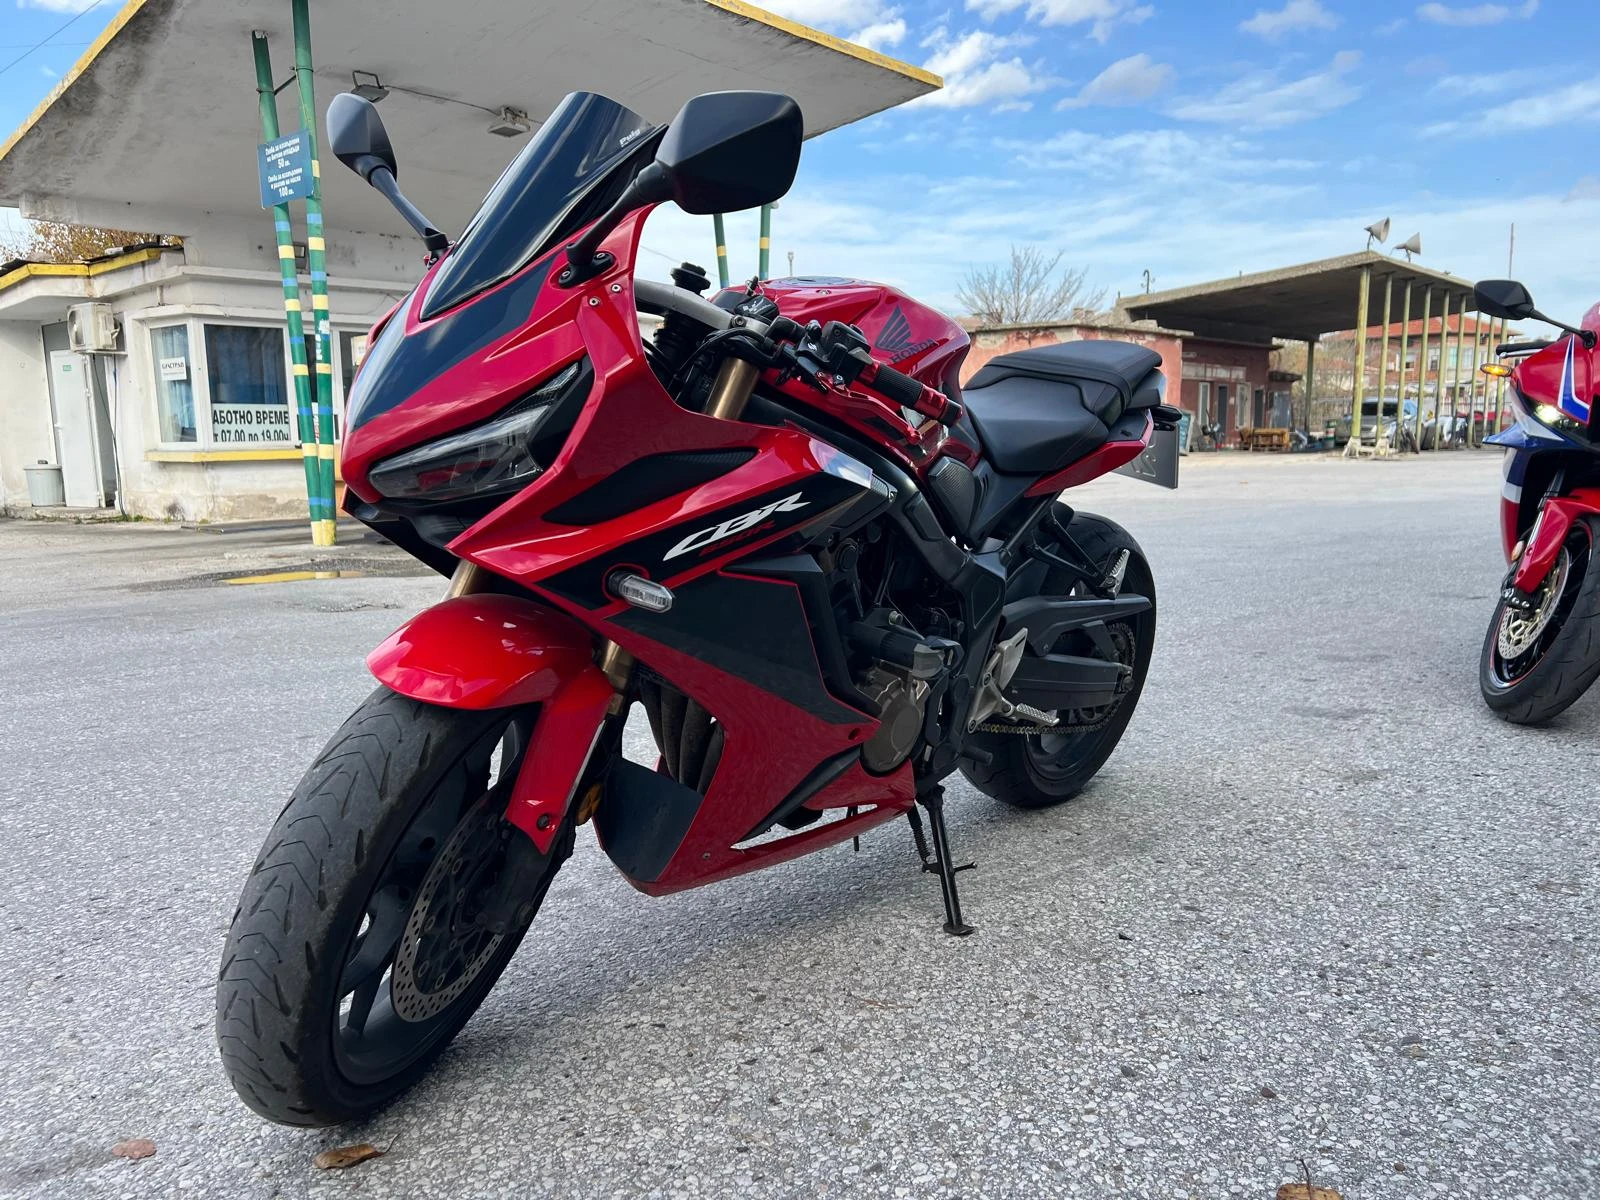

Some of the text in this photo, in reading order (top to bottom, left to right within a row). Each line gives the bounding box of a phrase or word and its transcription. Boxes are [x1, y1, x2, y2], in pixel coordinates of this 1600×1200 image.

[891, 338, 939, 363] HONDA
[212, 409, 289, 425] АБОТНО ВРЕМЕ
[221, 429, 246, 442] 07.00
[662, 491, 812, 562] CBR
